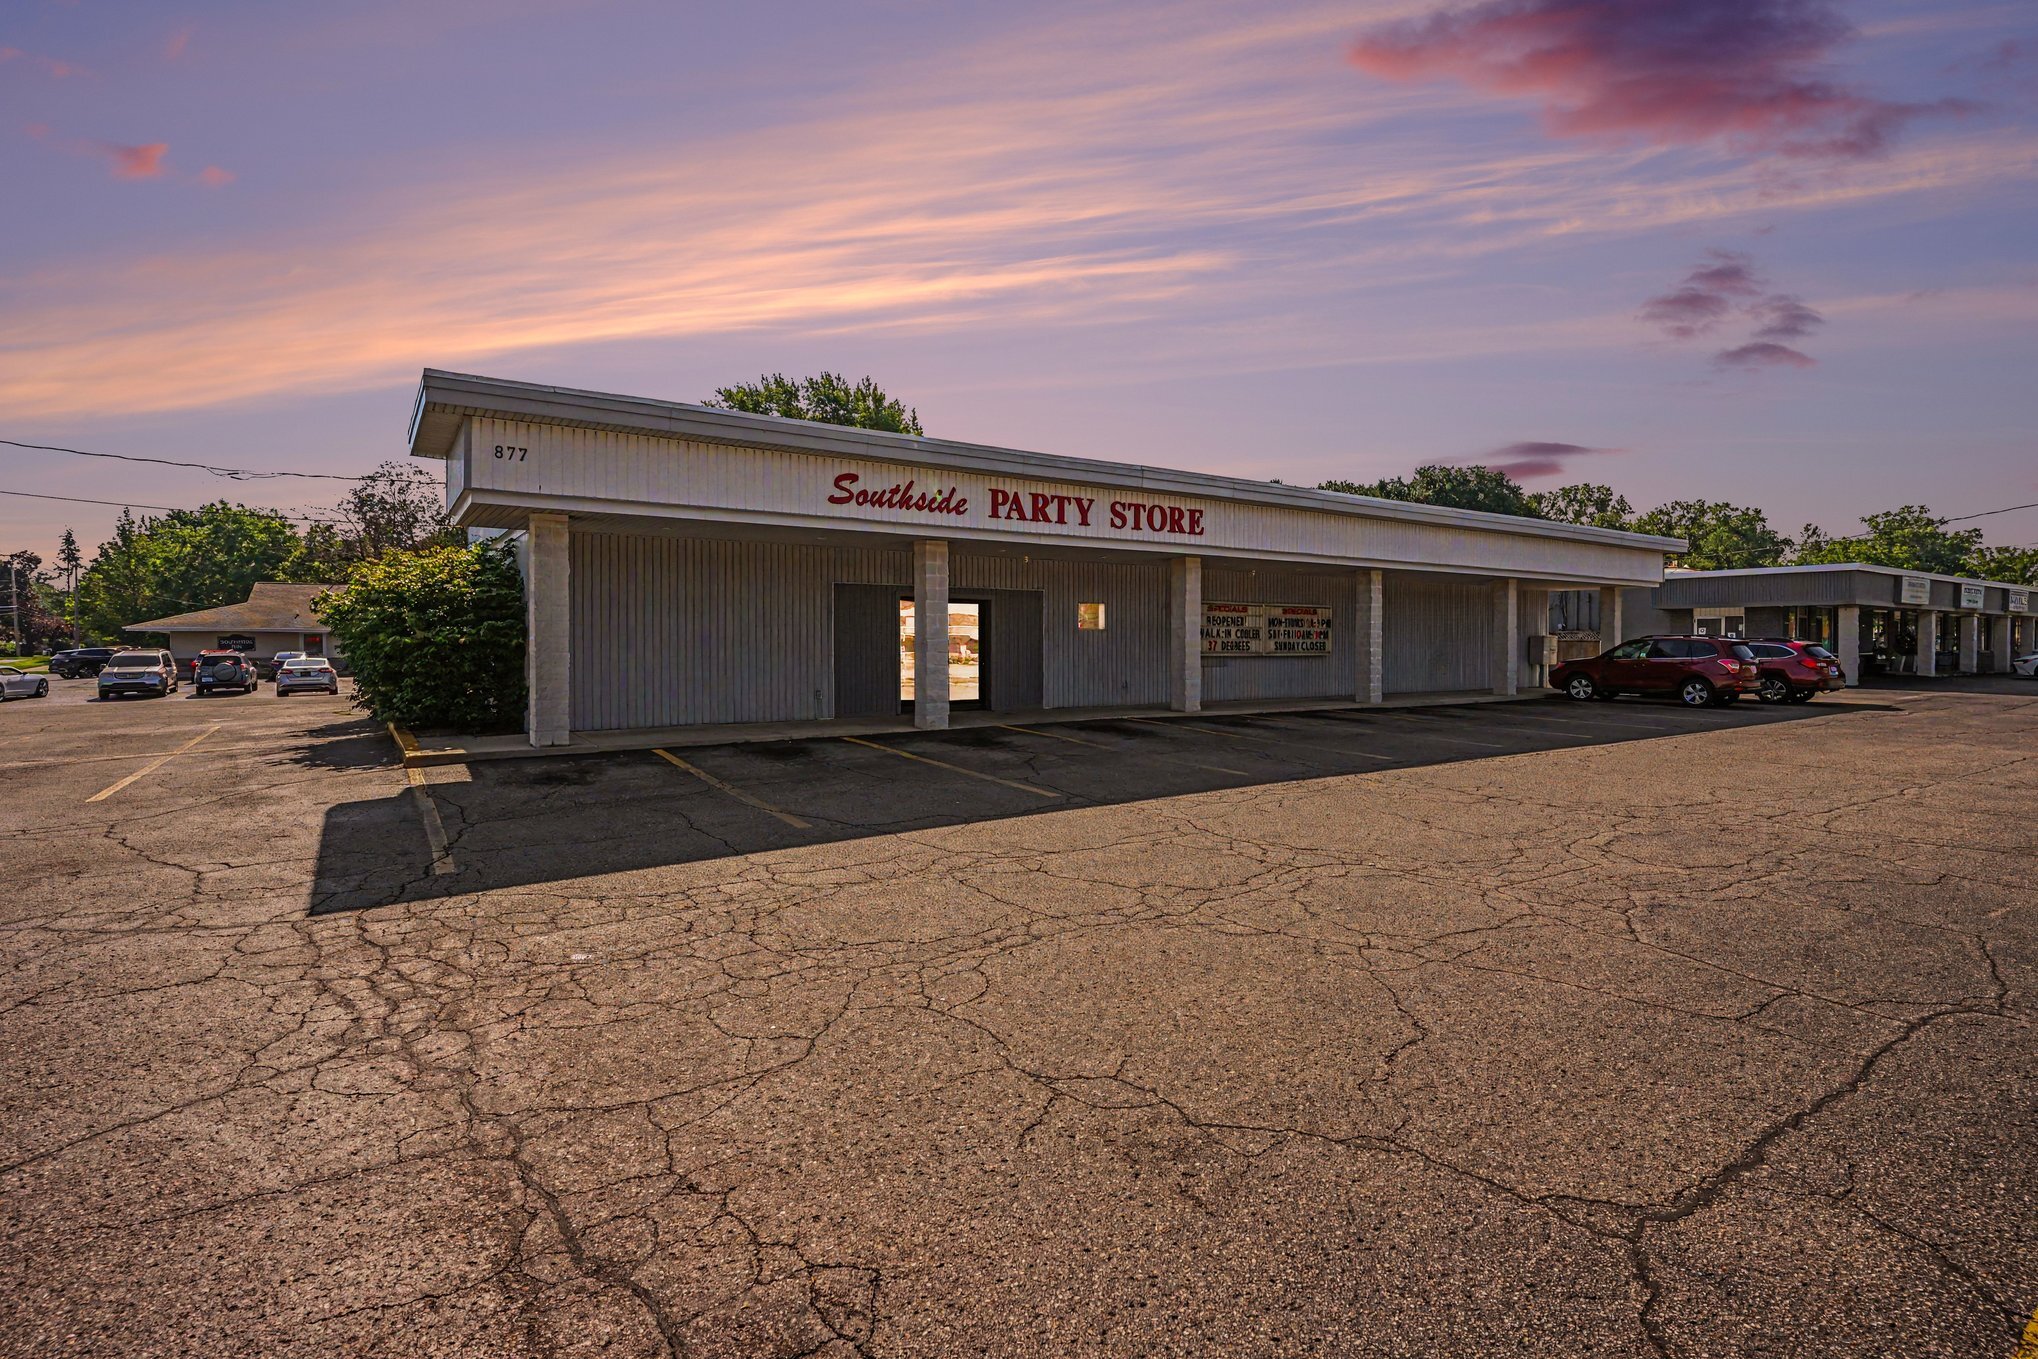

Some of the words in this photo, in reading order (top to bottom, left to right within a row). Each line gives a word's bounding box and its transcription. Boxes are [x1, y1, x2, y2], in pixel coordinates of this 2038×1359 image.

[494, 445, 528, 461] 877
[827, 472, 969, 517] Southside
[988, 488, 1095, 527] PARTY
[1109, 501, 1205, 536] STORE
[1206, 604, 1248, 613] SPECIALS
[1207, 640, 1218, 651] 37
[1221, 641, 1250, 651] DEGREES
[1274, 641, 1300, 651] SUNDAY
[1301, 642, 1327, 651] CLOSED
